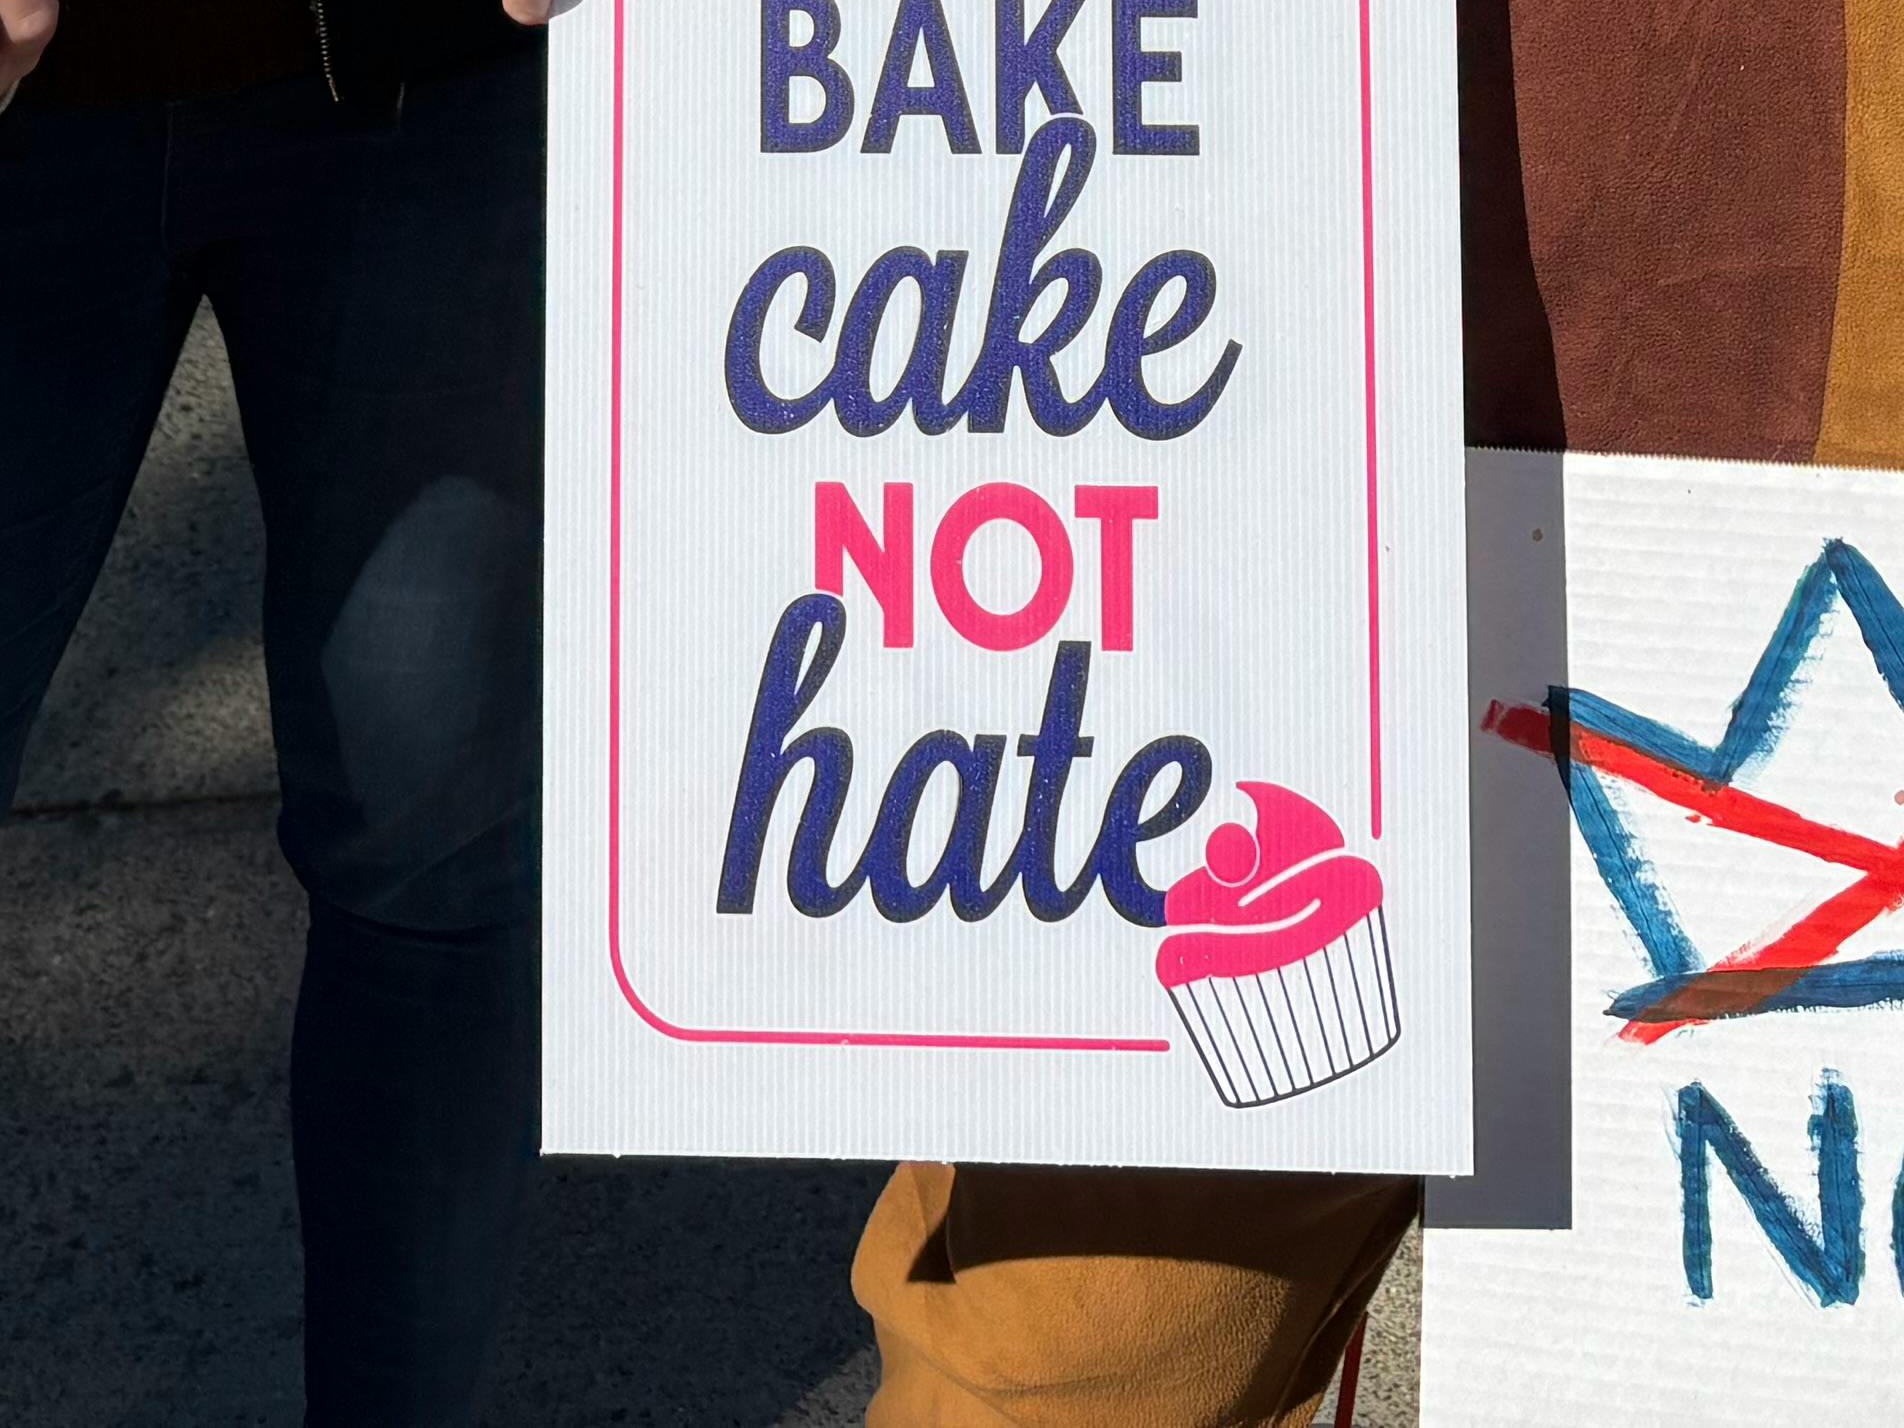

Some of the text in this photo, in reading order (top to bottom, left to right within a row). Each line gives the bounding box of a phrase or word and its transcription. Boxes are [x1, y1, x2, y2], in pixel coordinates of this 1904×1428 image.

[722, 113, 1242, 441] cake
[814, 480, 1159, 652] NOT
[715, 592, 1213, 927] hate
